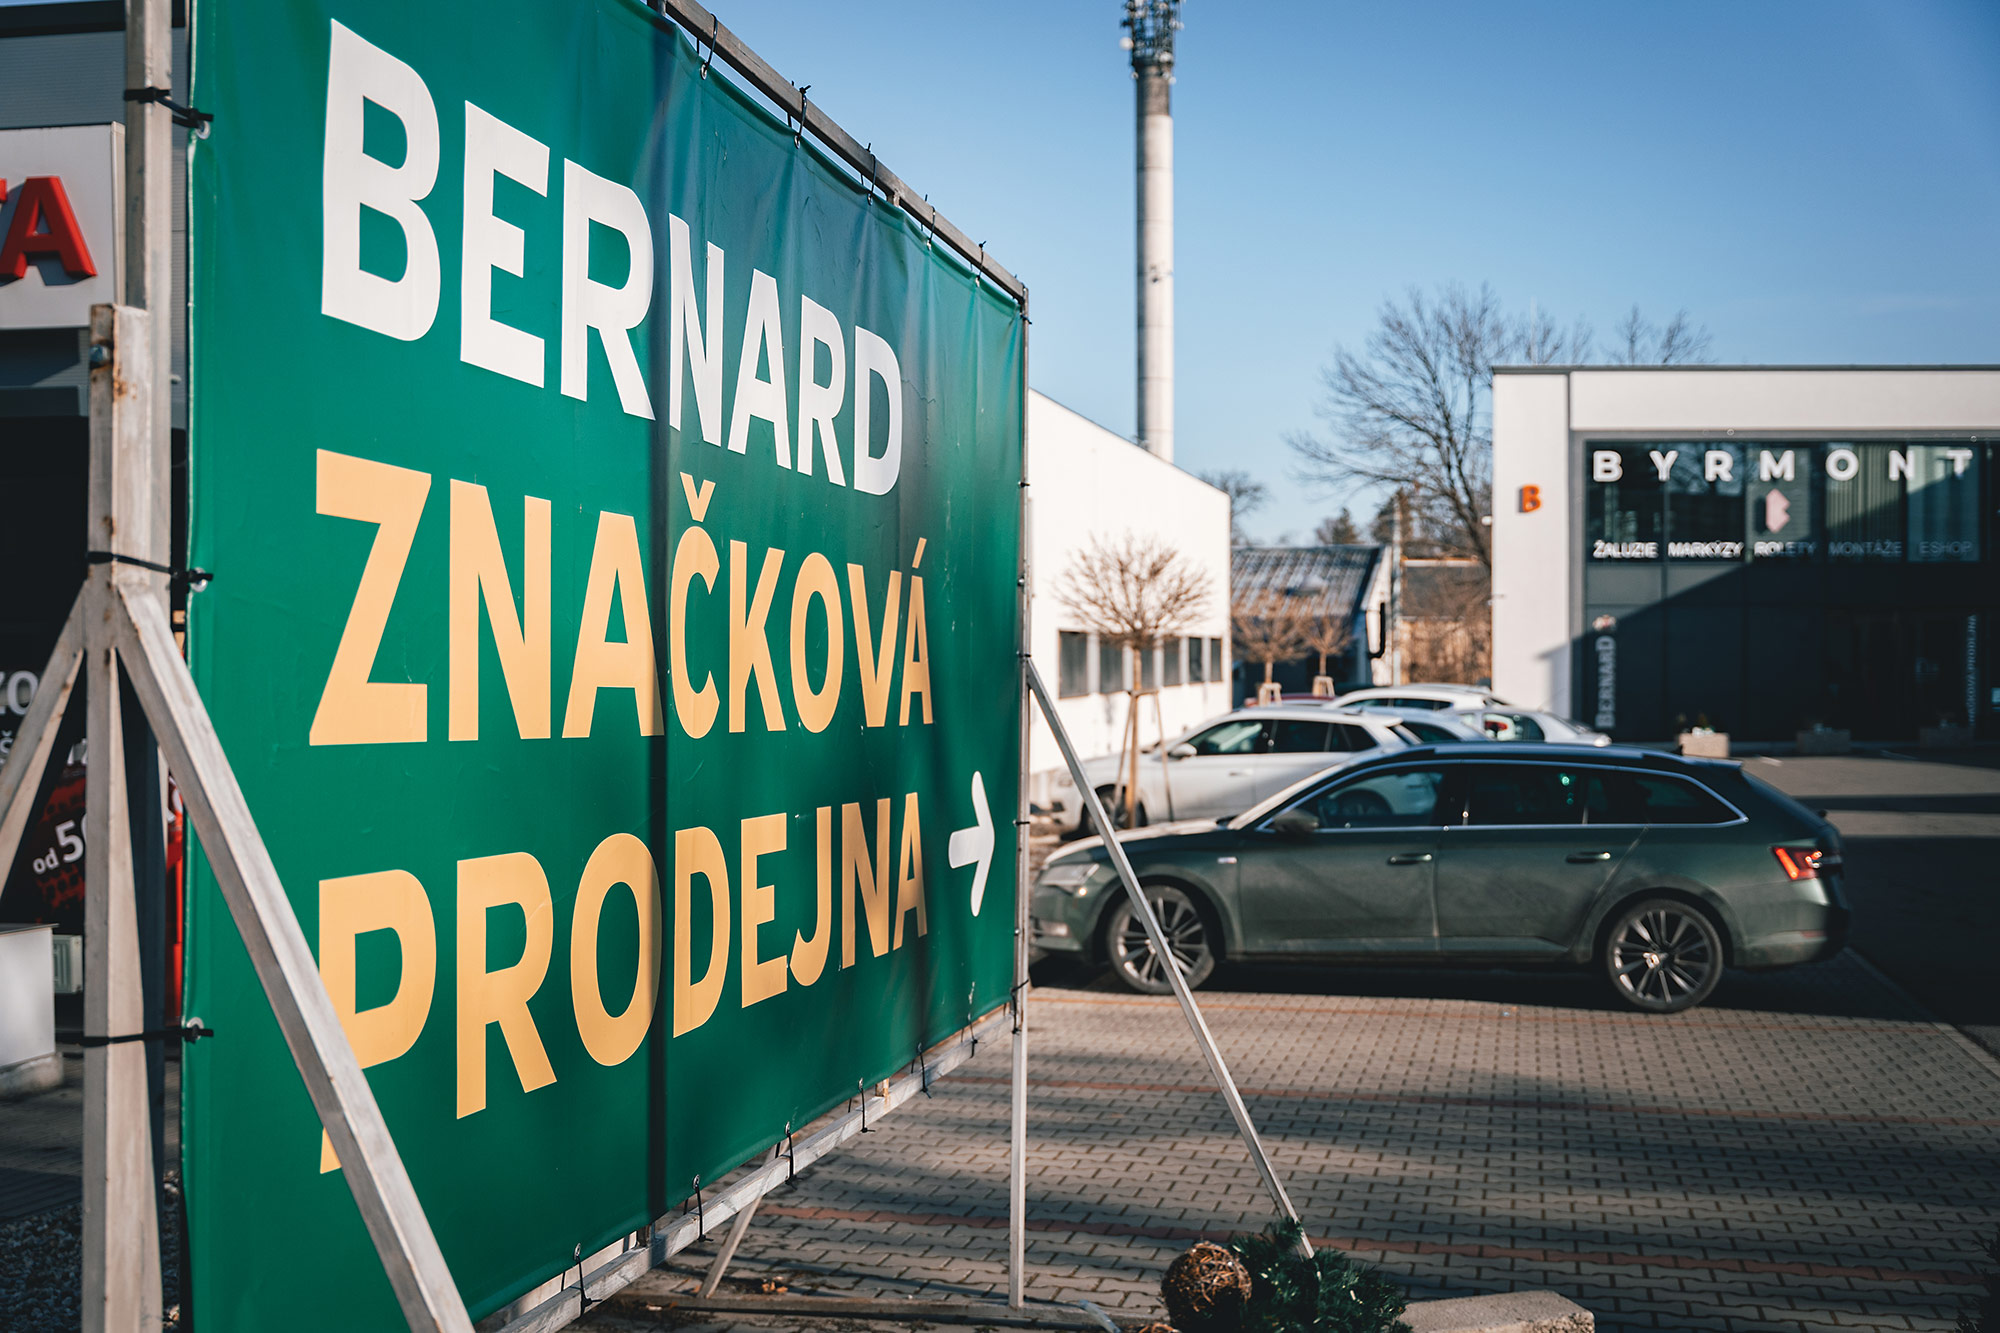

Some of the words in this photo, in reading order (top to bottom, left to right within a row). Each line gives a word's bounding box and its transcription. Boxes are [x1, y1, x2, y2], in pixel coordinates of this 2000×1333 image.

[0, 176, 97, 280] A
[322, 18, 902, 496] BERNARD
[1593, 449, 1973, 482] BYRMONT
[309, 448, 933, 746] ZNAČKOVÁ
[1593, 539, 1660, 559] ŽALUZIE
[1667, 540, 1745, 558] MARKÝZY
[1754, 541, 1816, 558] ROLETY
[1828, 538, 1902, 557] MONTÁŽE
[1918, 541, 1973, 557] ESHOP
[1594, 635, 1615, 728] BERNARD
[33, 847, 59, 874] od
[55, 811, 86, 862] 5
[319, 792, 928, 1174] PRODEJNA
